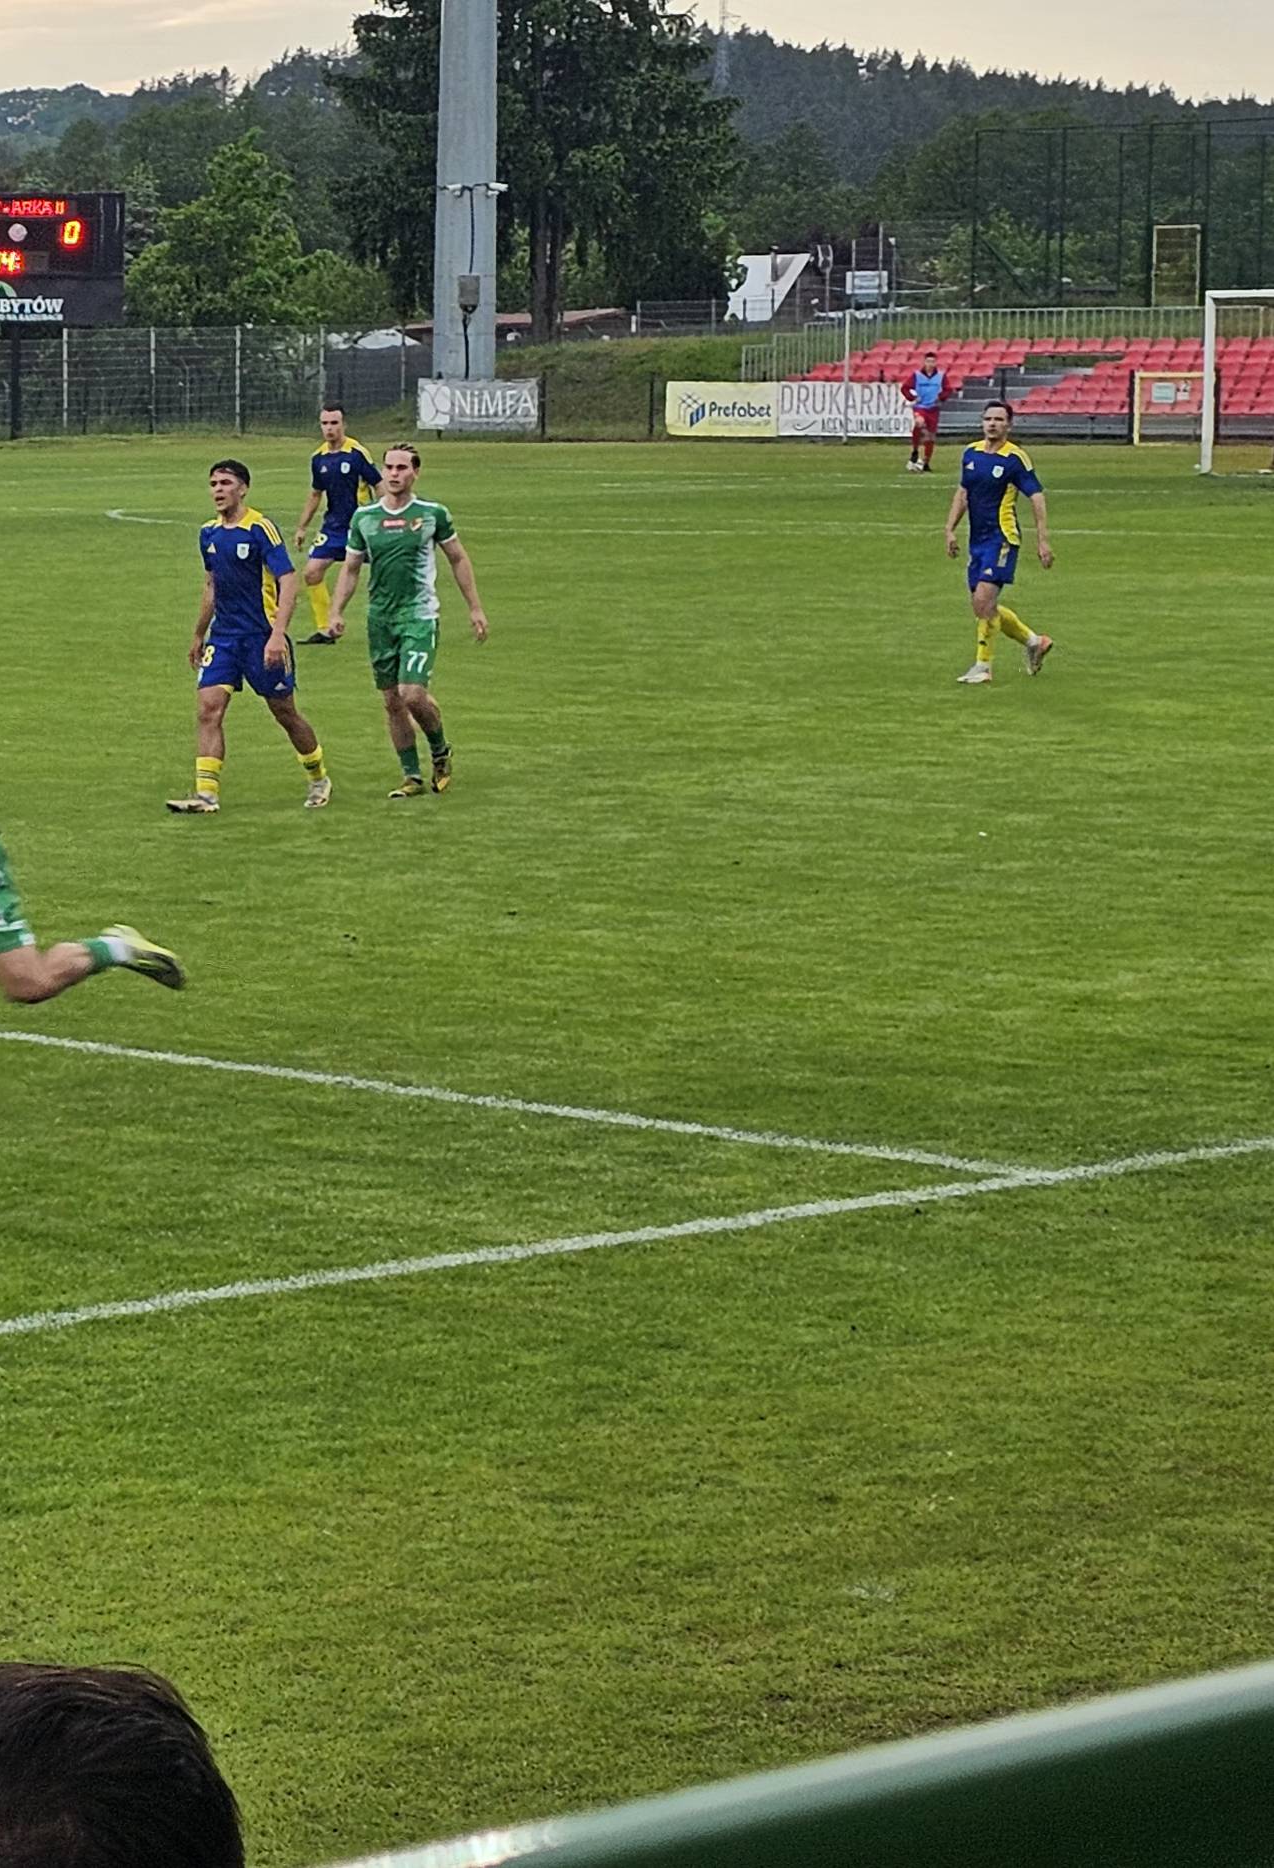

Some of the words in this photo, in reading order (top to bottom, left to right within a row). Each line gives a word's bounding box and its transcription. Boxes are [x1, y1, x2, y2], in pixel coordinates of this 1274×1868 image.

[63, 220, 82, 244] 0
[709, 401, 771, 417] Prefabet
[407, 651, 428, 673] 77
